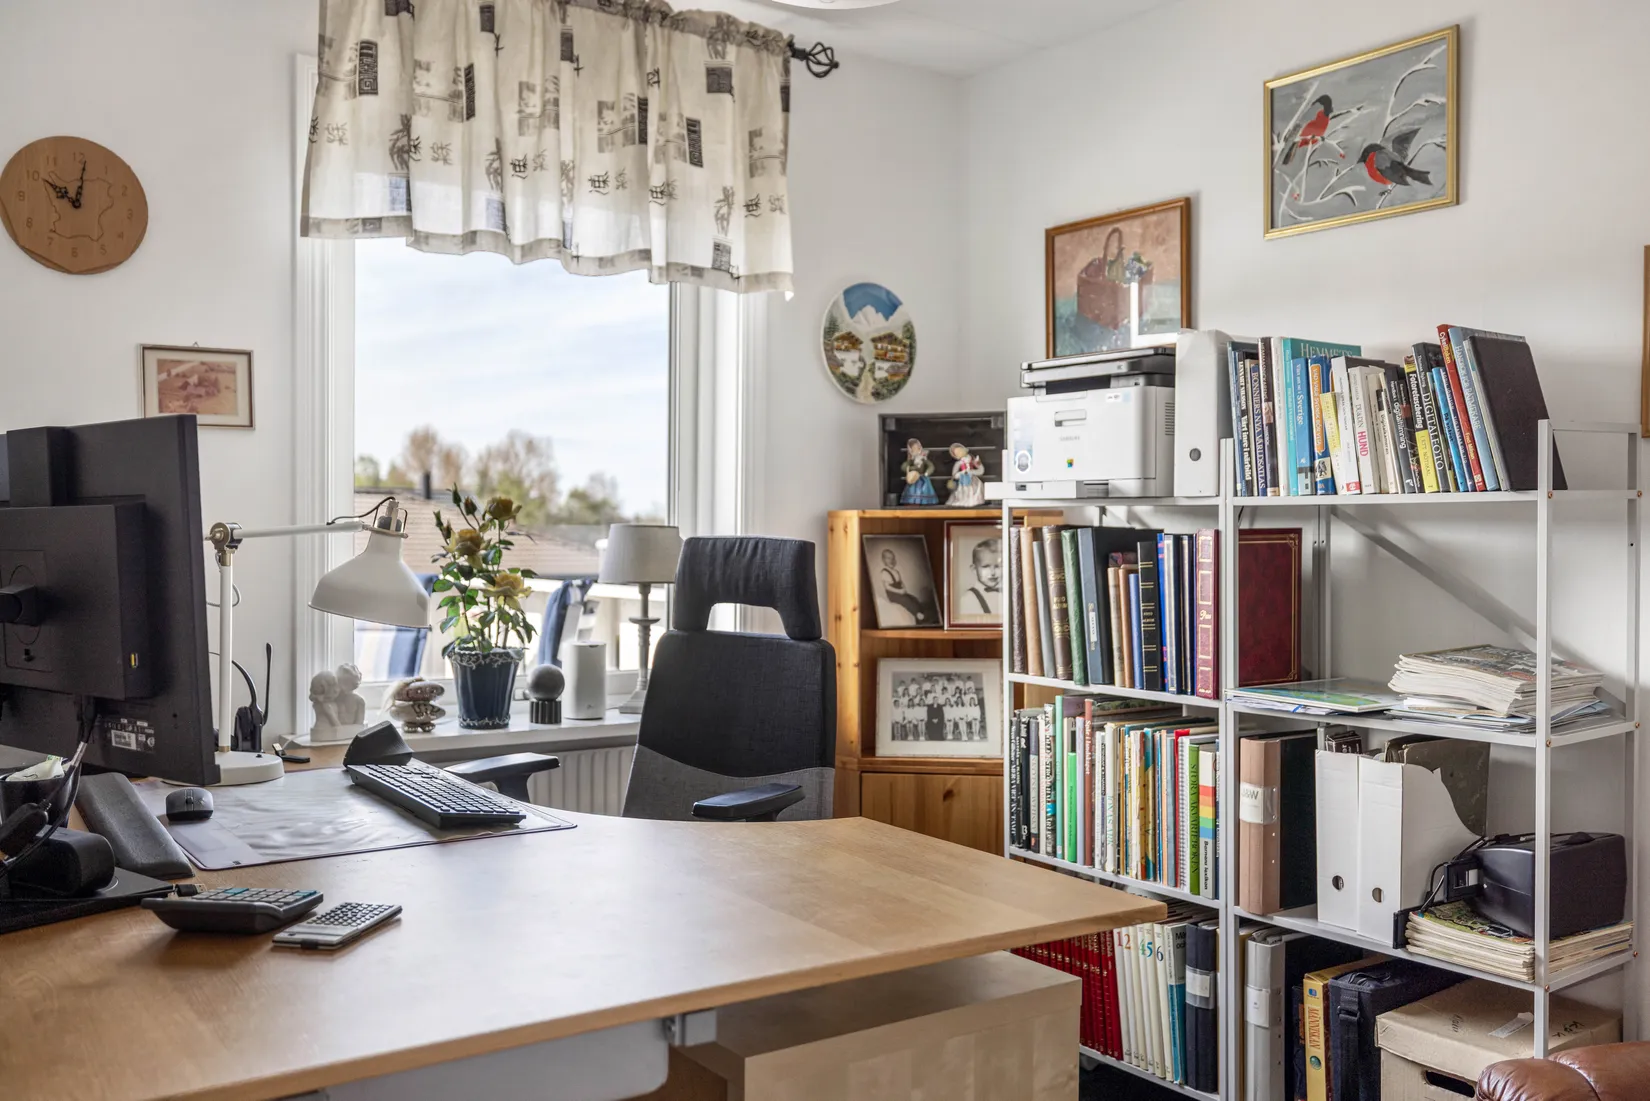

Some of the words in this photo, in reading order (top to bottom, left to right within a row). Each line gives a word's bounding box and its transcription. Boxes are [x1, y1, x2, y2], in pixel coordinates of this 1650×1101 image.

[26, 170, 39, 181] 10
[121, 185, 128, 197] 2
[127, 208, 133, 220] 3
[1252, 371, 1261, 414] BONNIERS
[1409, 373, 1424, 429] Fotoretuschering
[1297, 394, 1305, 425] Sverige
[1394, 402, 1407, 449] digitalfilmning
[1423, 392, 1444, 470] DIGITALFOTO
[1357, 431, 1368, 457] HUND
[1190, 763, 1198, 795] STORA
[1190, 799, 1198, 874] AKVARIEBOKEN
[1117, 932, 1123, 946] 1
[1124, 933, 1131, 950] 2
[1140, 939, 1146, 956] 4
[1146, 942, 1153, 957] 5
[1156, 946, 1164, 961] 6
[1308, 1006, 1321, 1050] MÄNNISKAN
